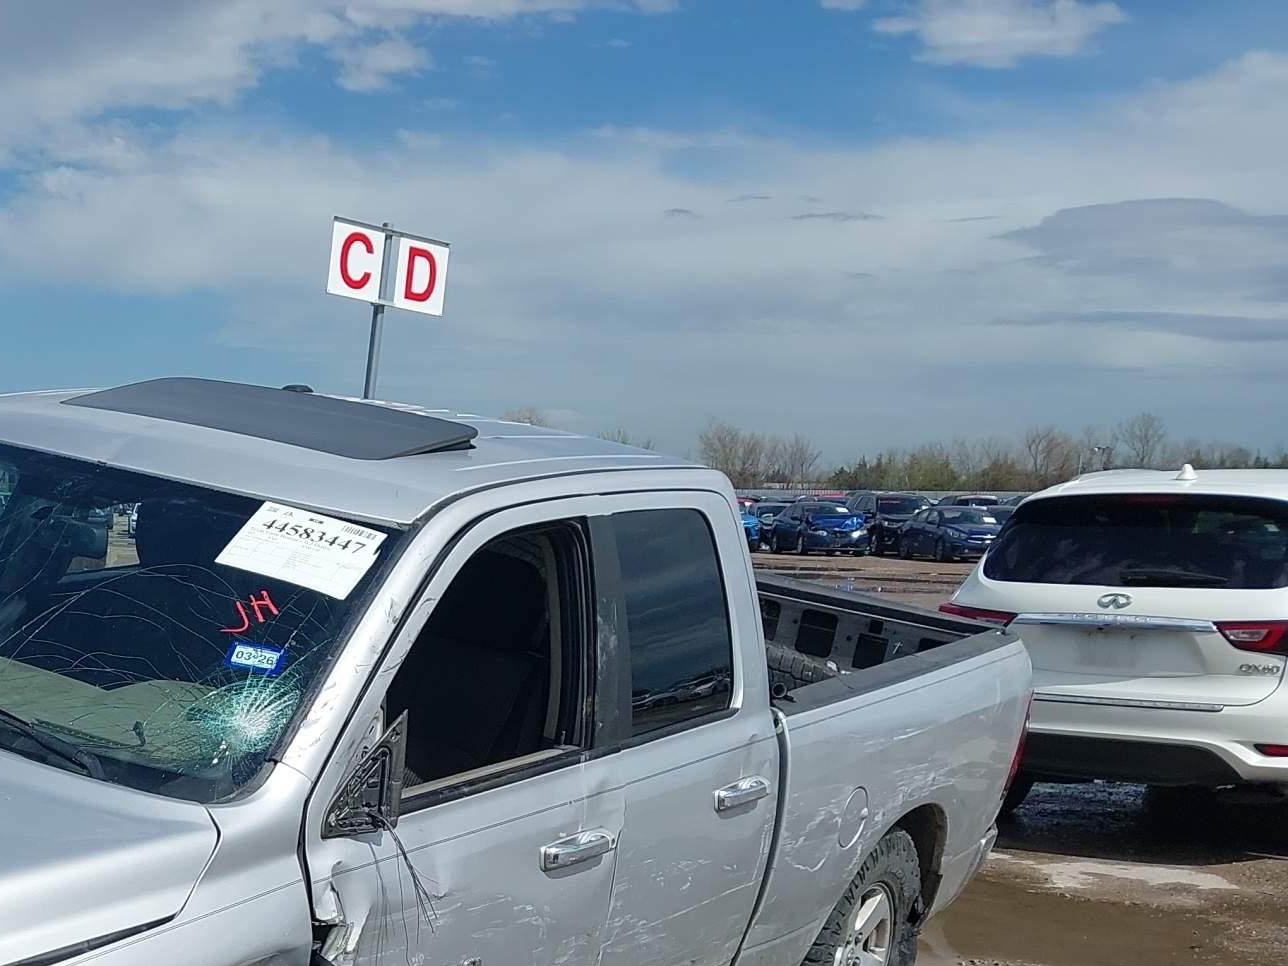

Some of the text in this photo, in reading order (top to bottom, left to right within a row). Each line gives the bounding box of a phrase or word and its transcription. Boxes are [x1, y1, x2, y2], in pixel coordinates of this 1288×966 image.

[339, 231, 375, 290] C
[403, 245, 437, 303] D
[262, 518, 367, 555] 44583447
[219, 590, 279, 633] JH
